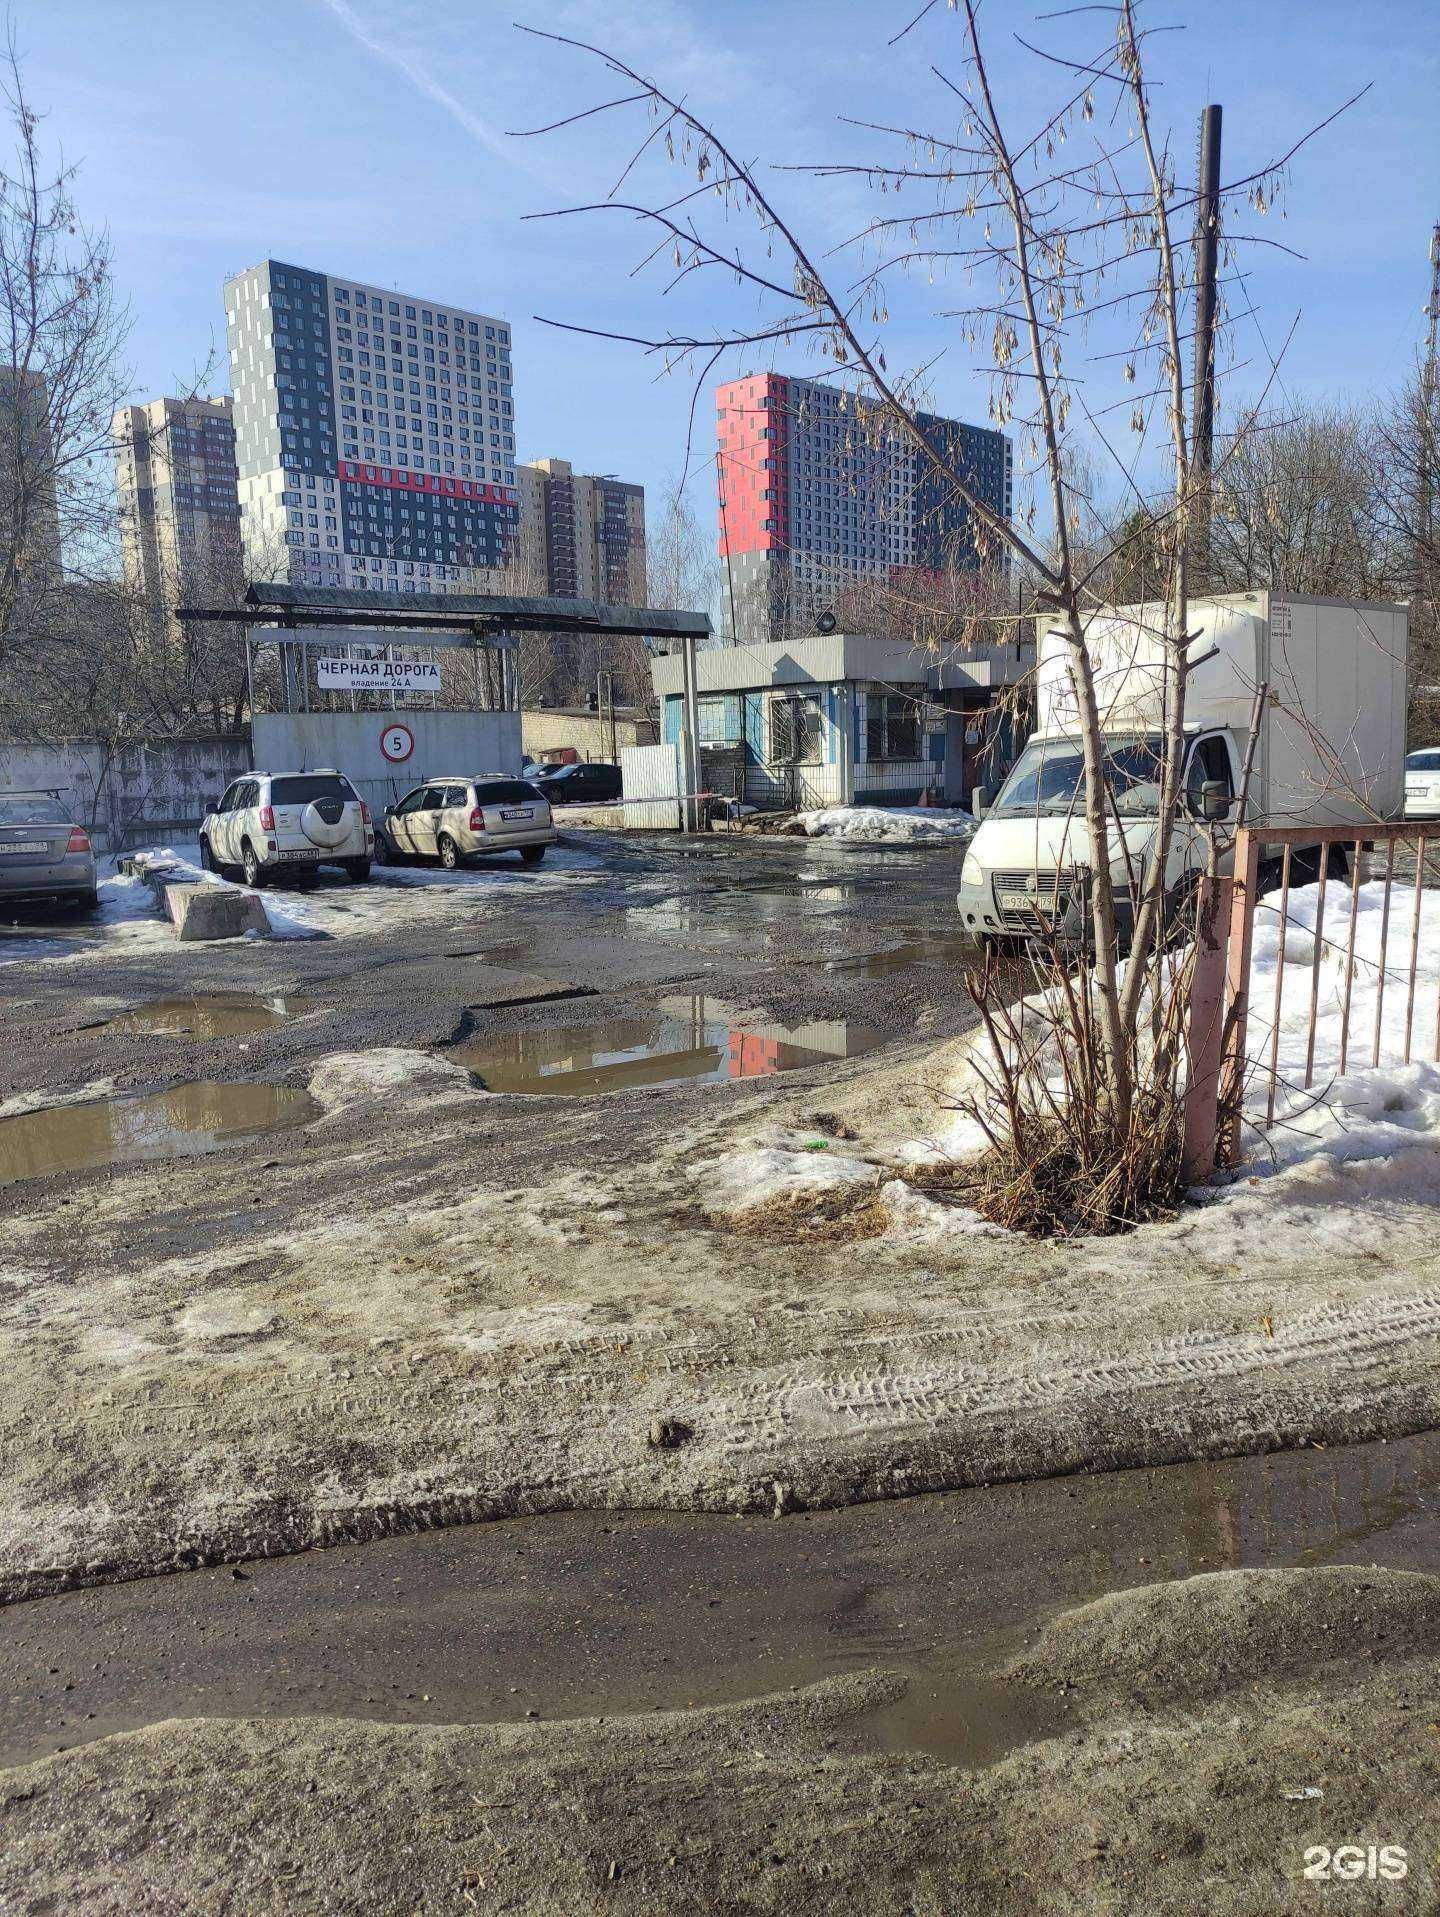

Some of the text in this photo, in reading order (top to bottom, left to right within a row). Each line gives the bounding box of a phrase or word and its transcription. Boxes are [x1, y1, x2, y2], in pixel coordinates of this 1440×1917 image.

[320, 662, 438, 677] ЧЕРНАЯ ДОРОГА
[351, 678, 411, 688] владение 24 А
[393, 737, 402, 751] 5
